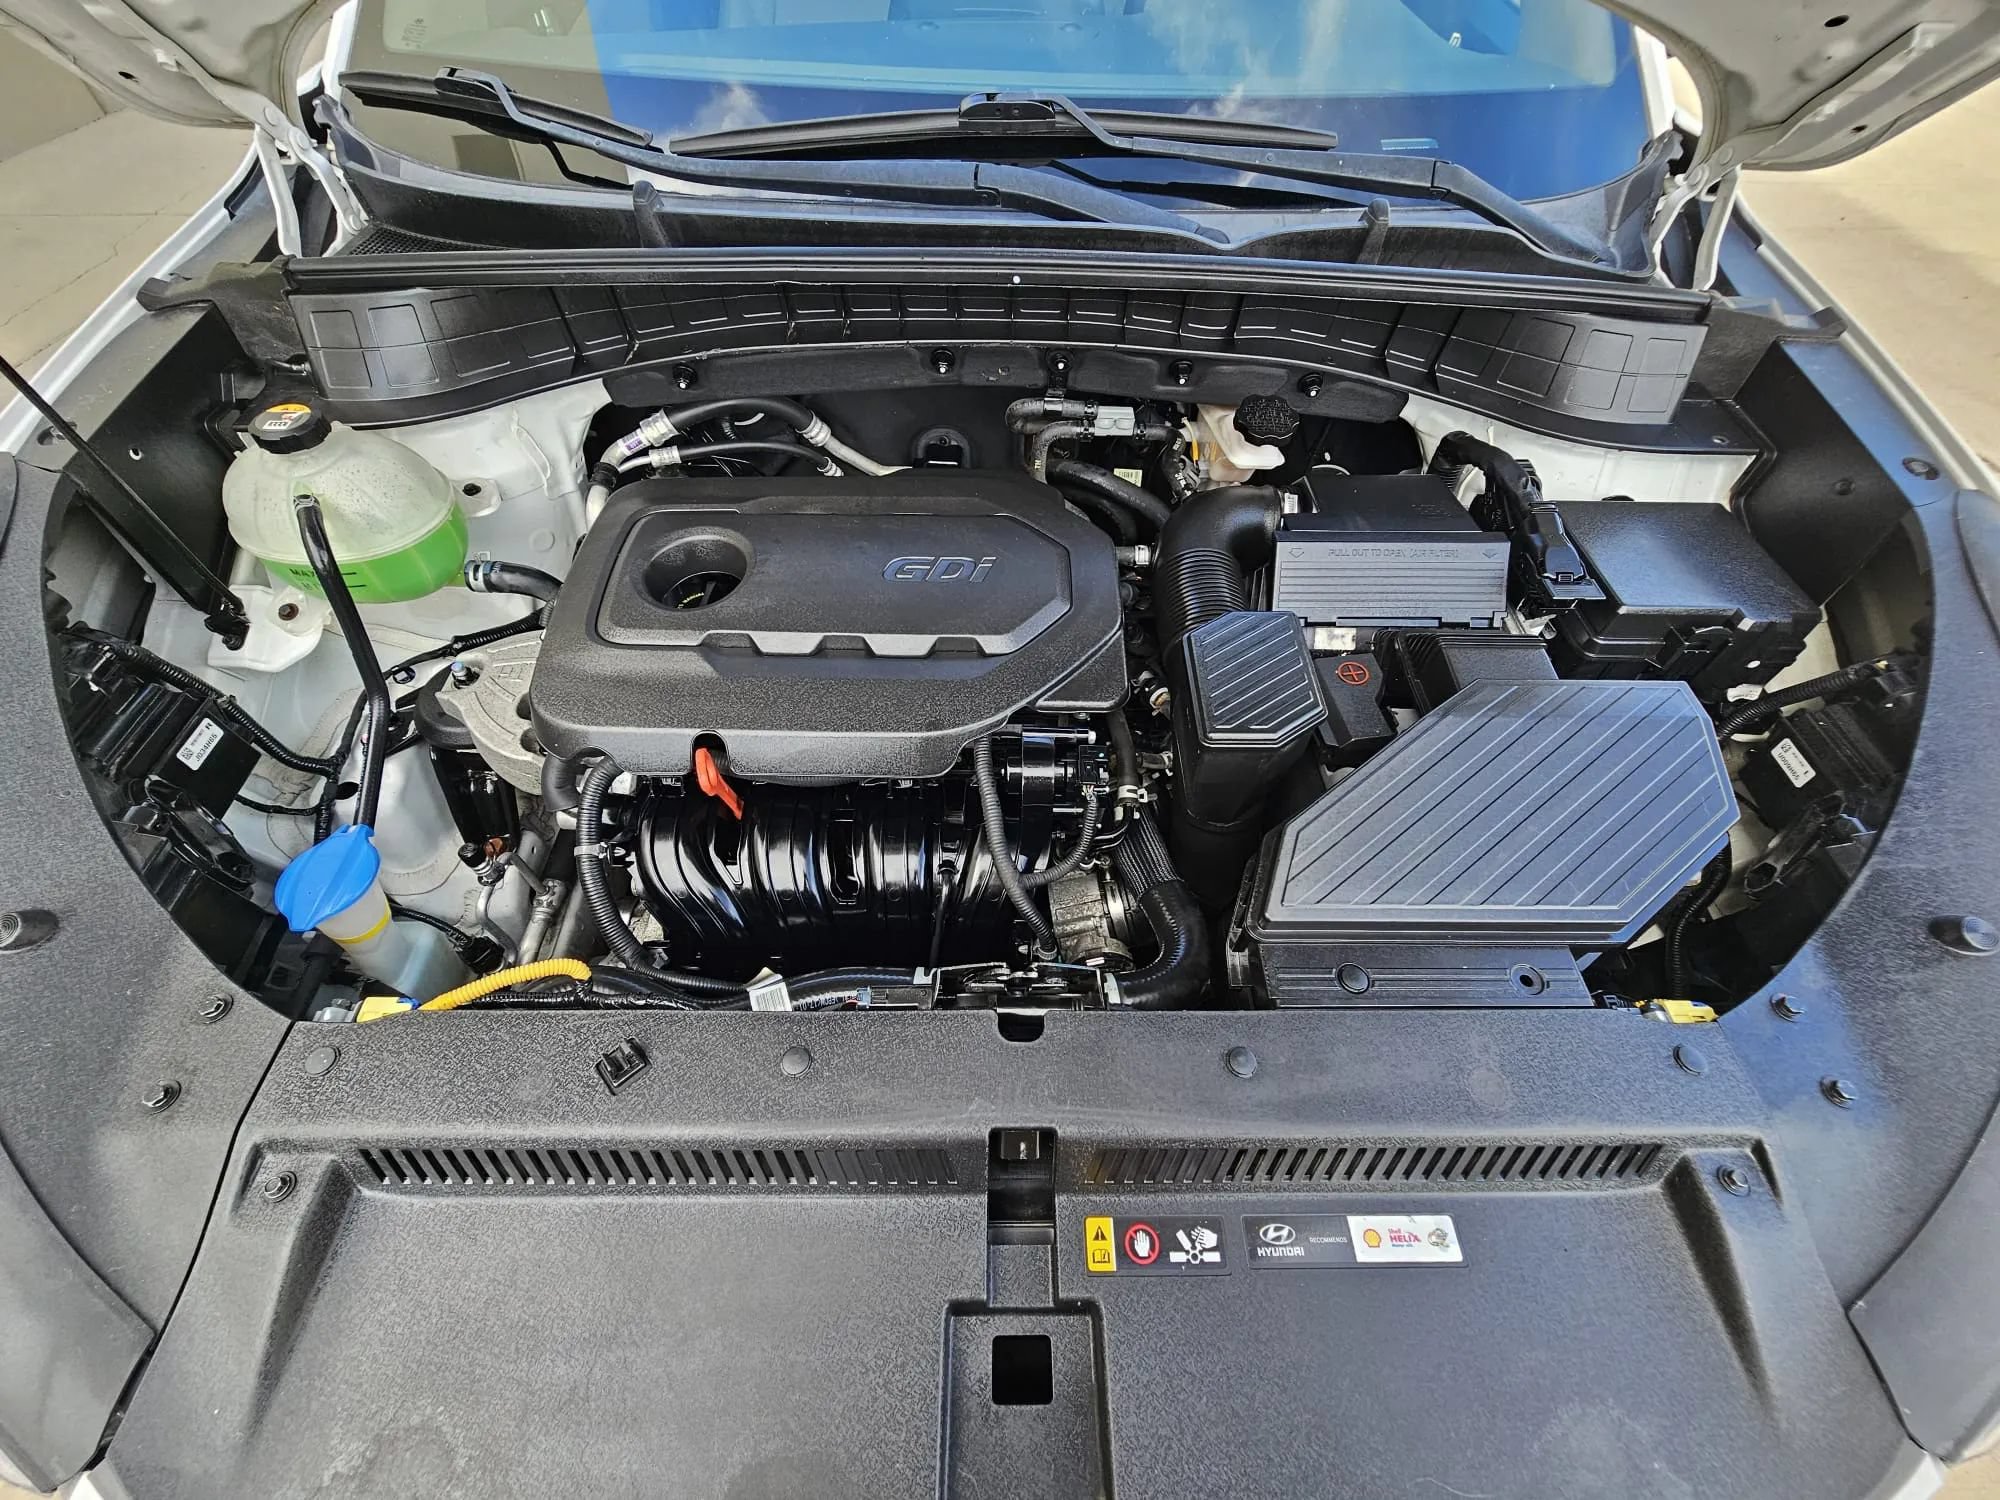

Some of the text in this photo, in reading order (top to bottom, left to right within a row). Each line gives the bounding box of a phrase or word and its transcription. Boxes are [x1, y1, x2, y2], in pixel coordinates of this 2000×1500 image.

[1328, 548, 1350, 557] PULL
[1352, 548, 1369, 557] OUT
[1371, 548, 1381, 557] TO
[1383, 548, 1406, 558] OPEN
[882, 556, 997, 584] GDi
[1389, 1233, 1422, 1243] HELIX
[1256, 1246, 1305, 1257] HYUNDAI
